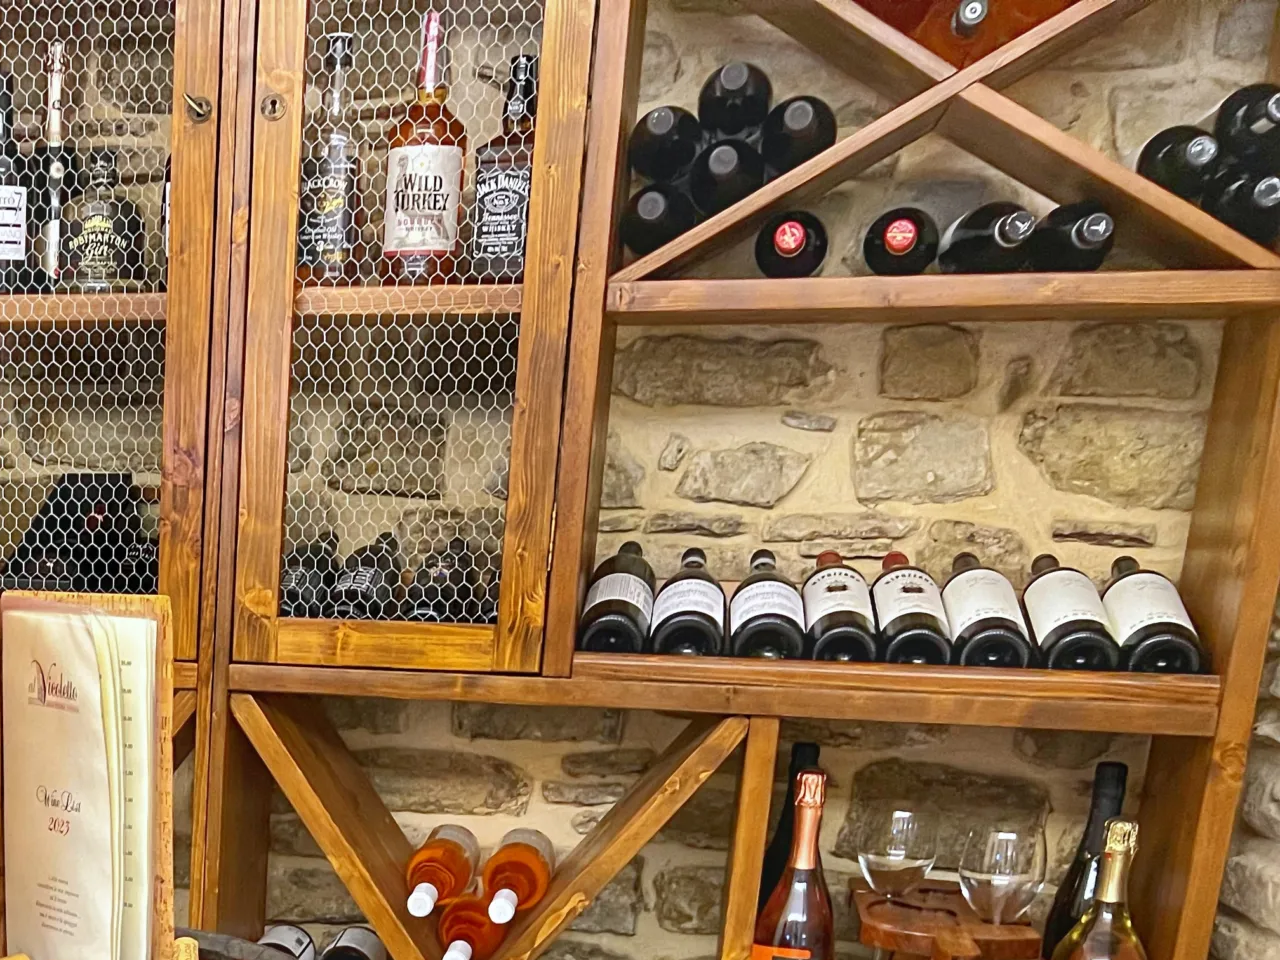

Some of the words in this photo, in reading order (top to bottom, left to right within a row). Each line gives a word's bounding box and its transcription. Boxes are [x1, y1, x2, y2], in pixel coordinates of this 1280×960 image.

[403, 173, 443, 192] WILD
[476, 179, 497, 196] JACK
[394, 189, 450, 213] TURKEY
[48, 816, 70, 836] 2023
